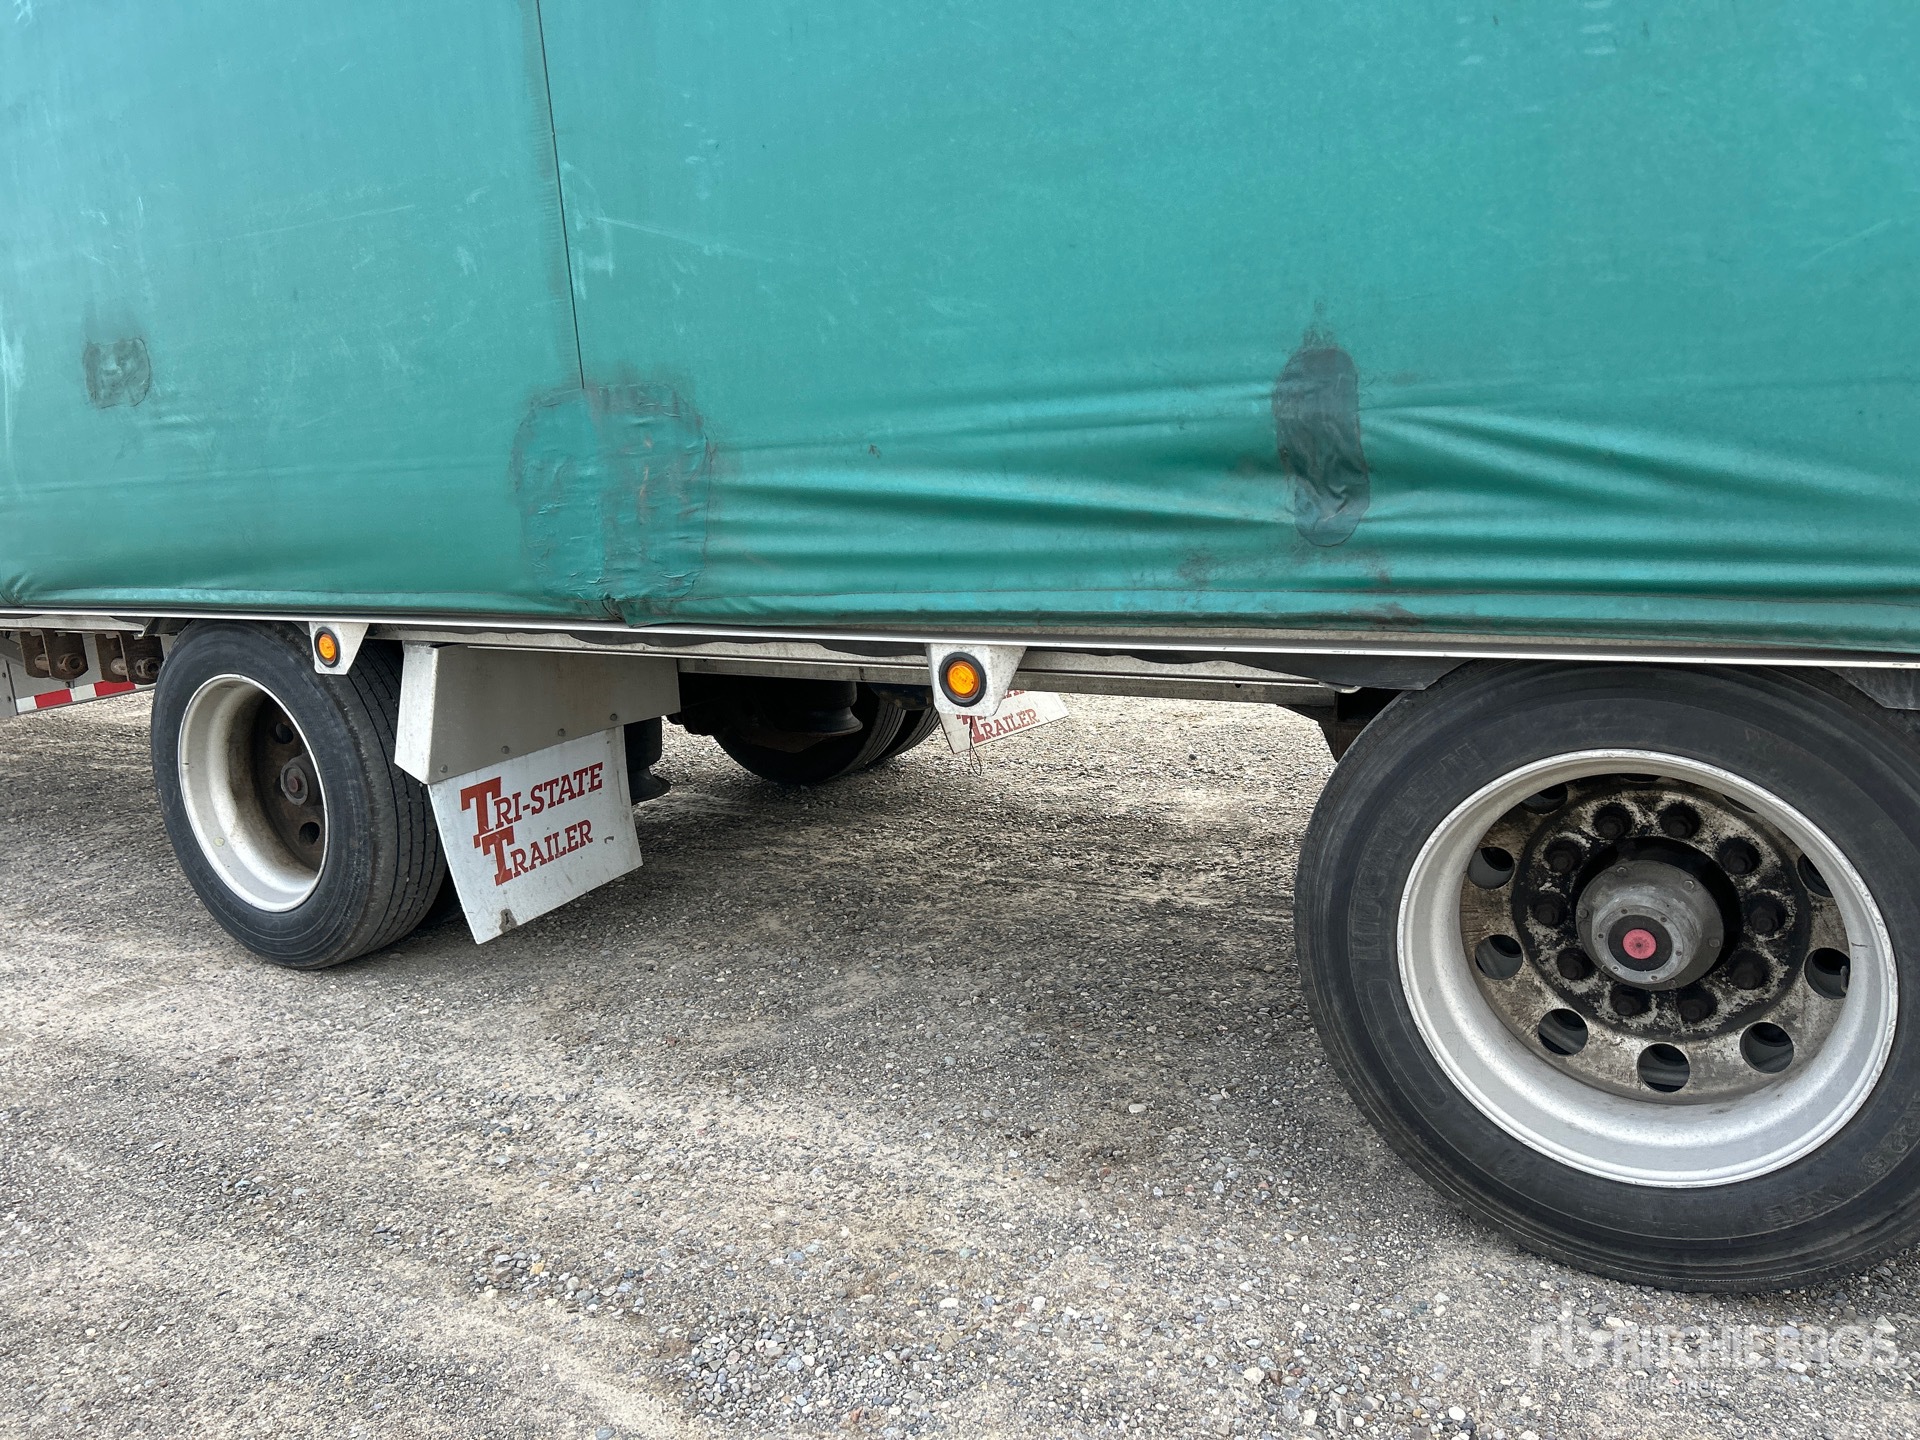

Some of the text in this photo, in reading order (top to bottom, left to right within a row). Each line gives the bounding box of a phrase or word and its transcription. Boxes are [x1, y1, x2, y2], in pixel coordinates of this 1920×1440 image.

[956, 708, 1041, 745] TRAILER
[460, 761, 603, 849] TRI-STATE
[481, 819, 594, 887] TRAILER
